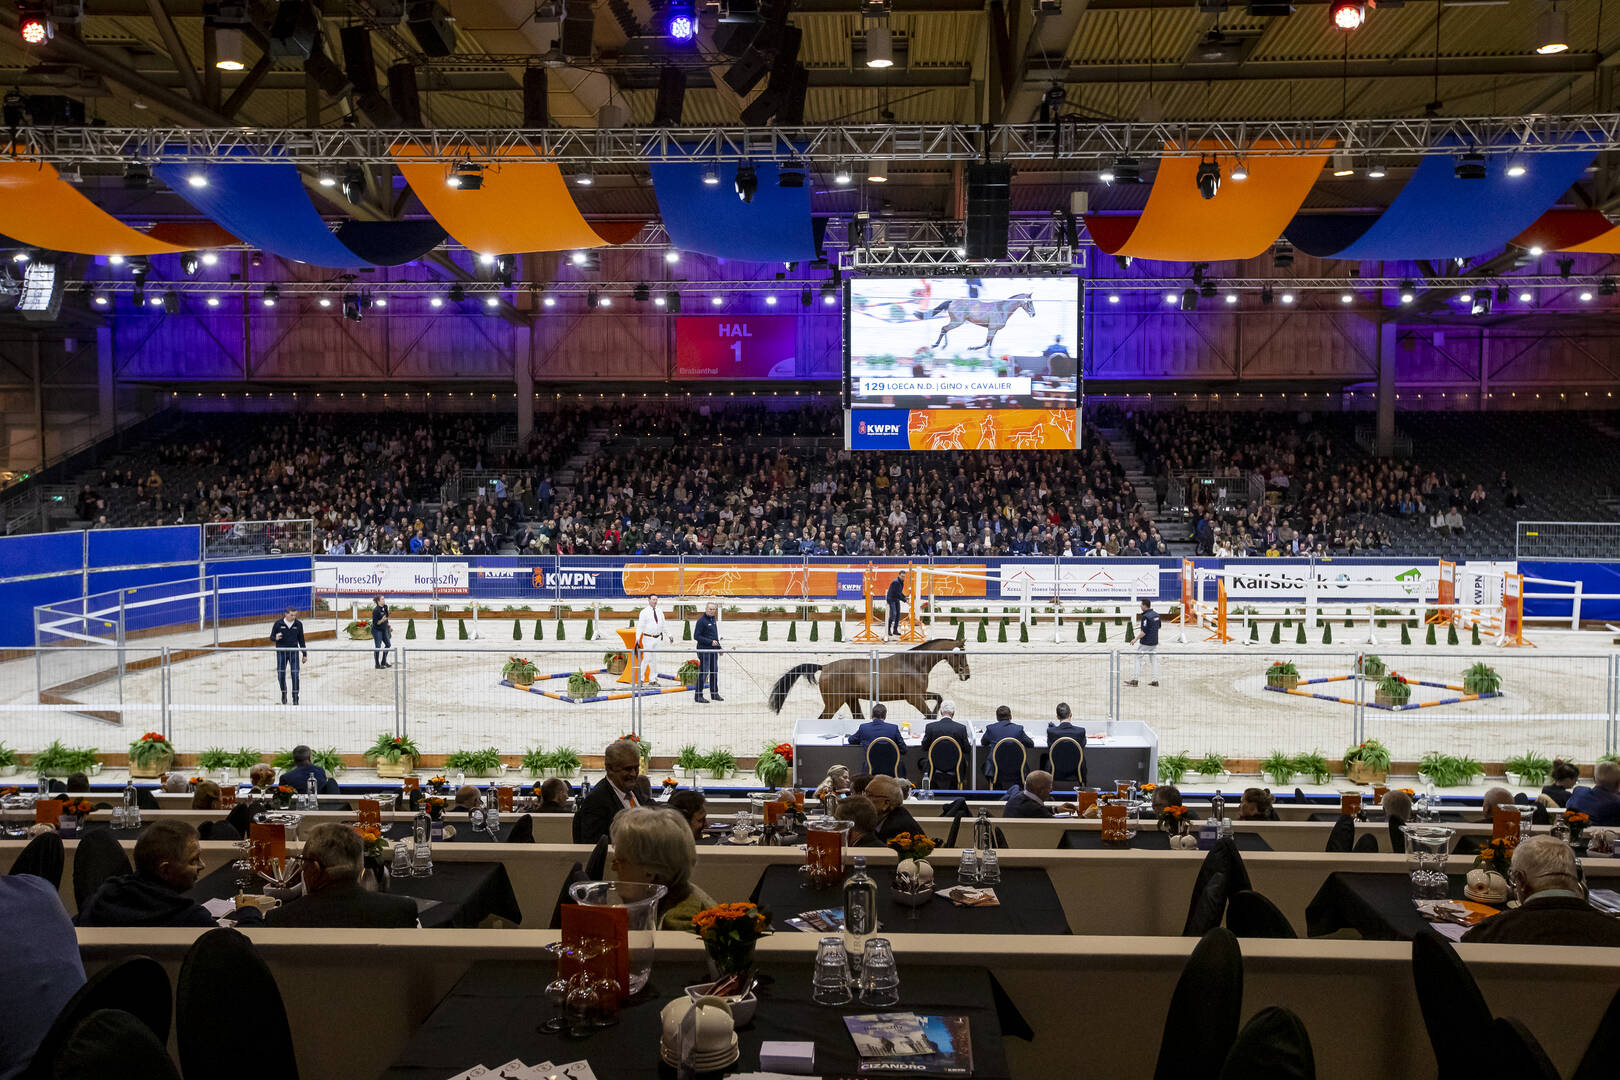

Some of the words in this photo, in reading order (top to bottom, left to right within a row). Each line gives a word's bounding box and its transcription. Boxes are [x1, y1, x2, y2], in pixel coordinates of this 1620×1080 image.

[719, 324, 752, 336] HAL
[730, 341, 742, 361] 1
[864, 383, 885, 391] 129
[867, 425, 899, 433] KWPN
[338, 574, 383, 586] Horses2fly
[546, 573, 596, 585] KWPN
[1233, 573, 1328, 589] Kalfsbek
[1474, 576, 1483, 605] KWPN
[861, 1063, 926, 1071] CIZANDRO
